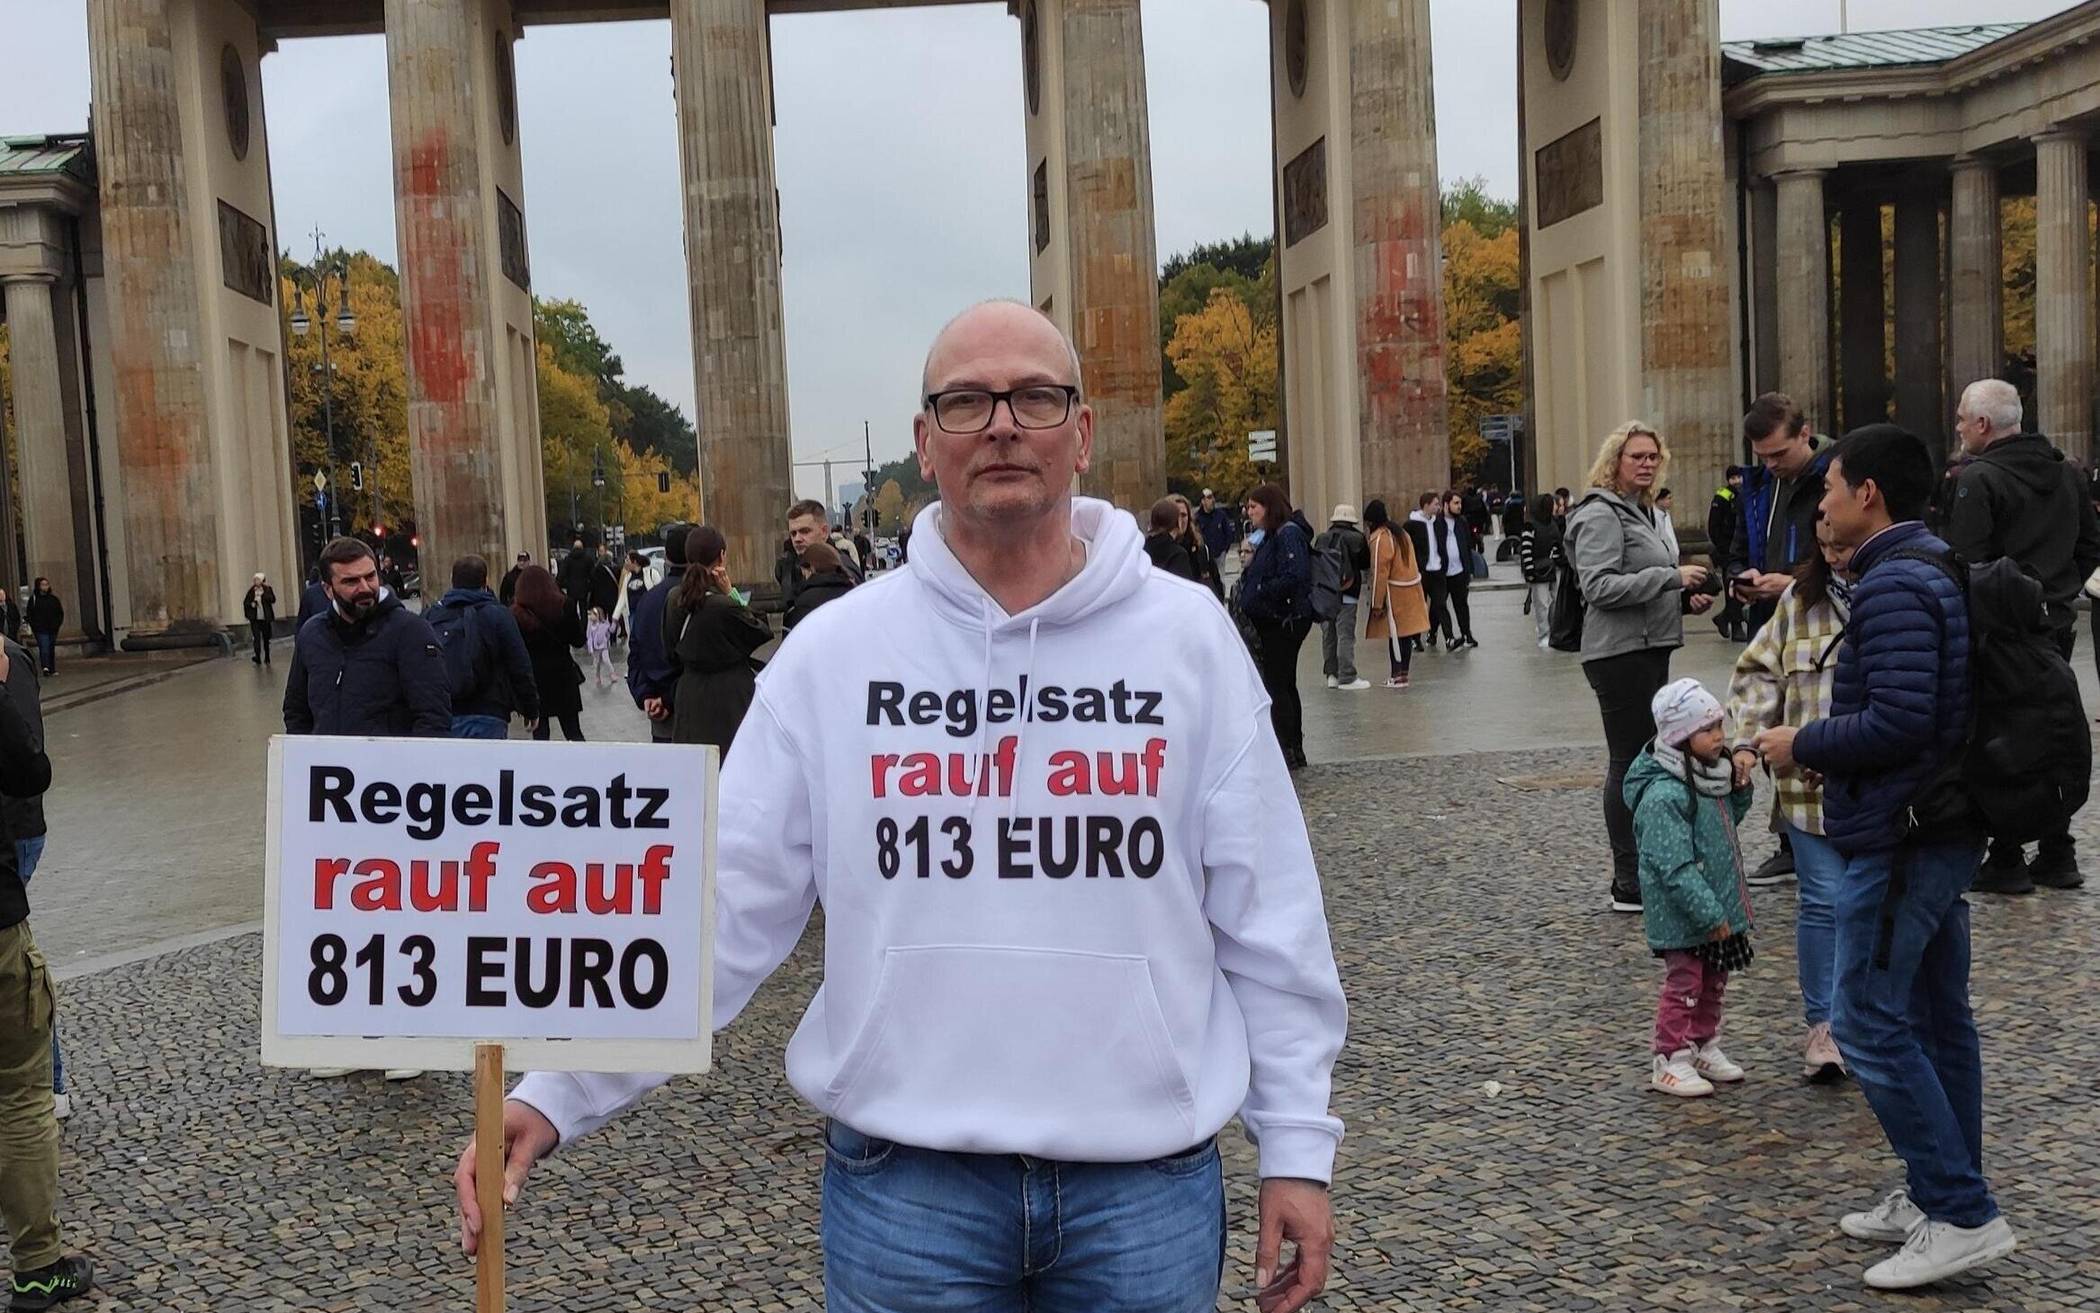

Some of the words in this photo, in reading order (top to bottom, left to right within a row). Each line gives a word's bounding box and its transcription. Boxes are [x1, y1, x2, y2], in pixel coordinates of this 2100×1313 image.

[866, 674, 1164, 737] Regelsatz
[871, 735, 1019, 798] rauf
[1047, 738, 1167, 798] auf
[309, 765, 670, 841] Regelsatz
[313, 841, 500, 912] rauf
[526, 845, 674, 915] auf
[876, 816, 975, 879] 813
[998, 815, 1165, 879] EURO
[307, 933, 438, 1007] 813
[465, 936, 669, 1010] EURO
